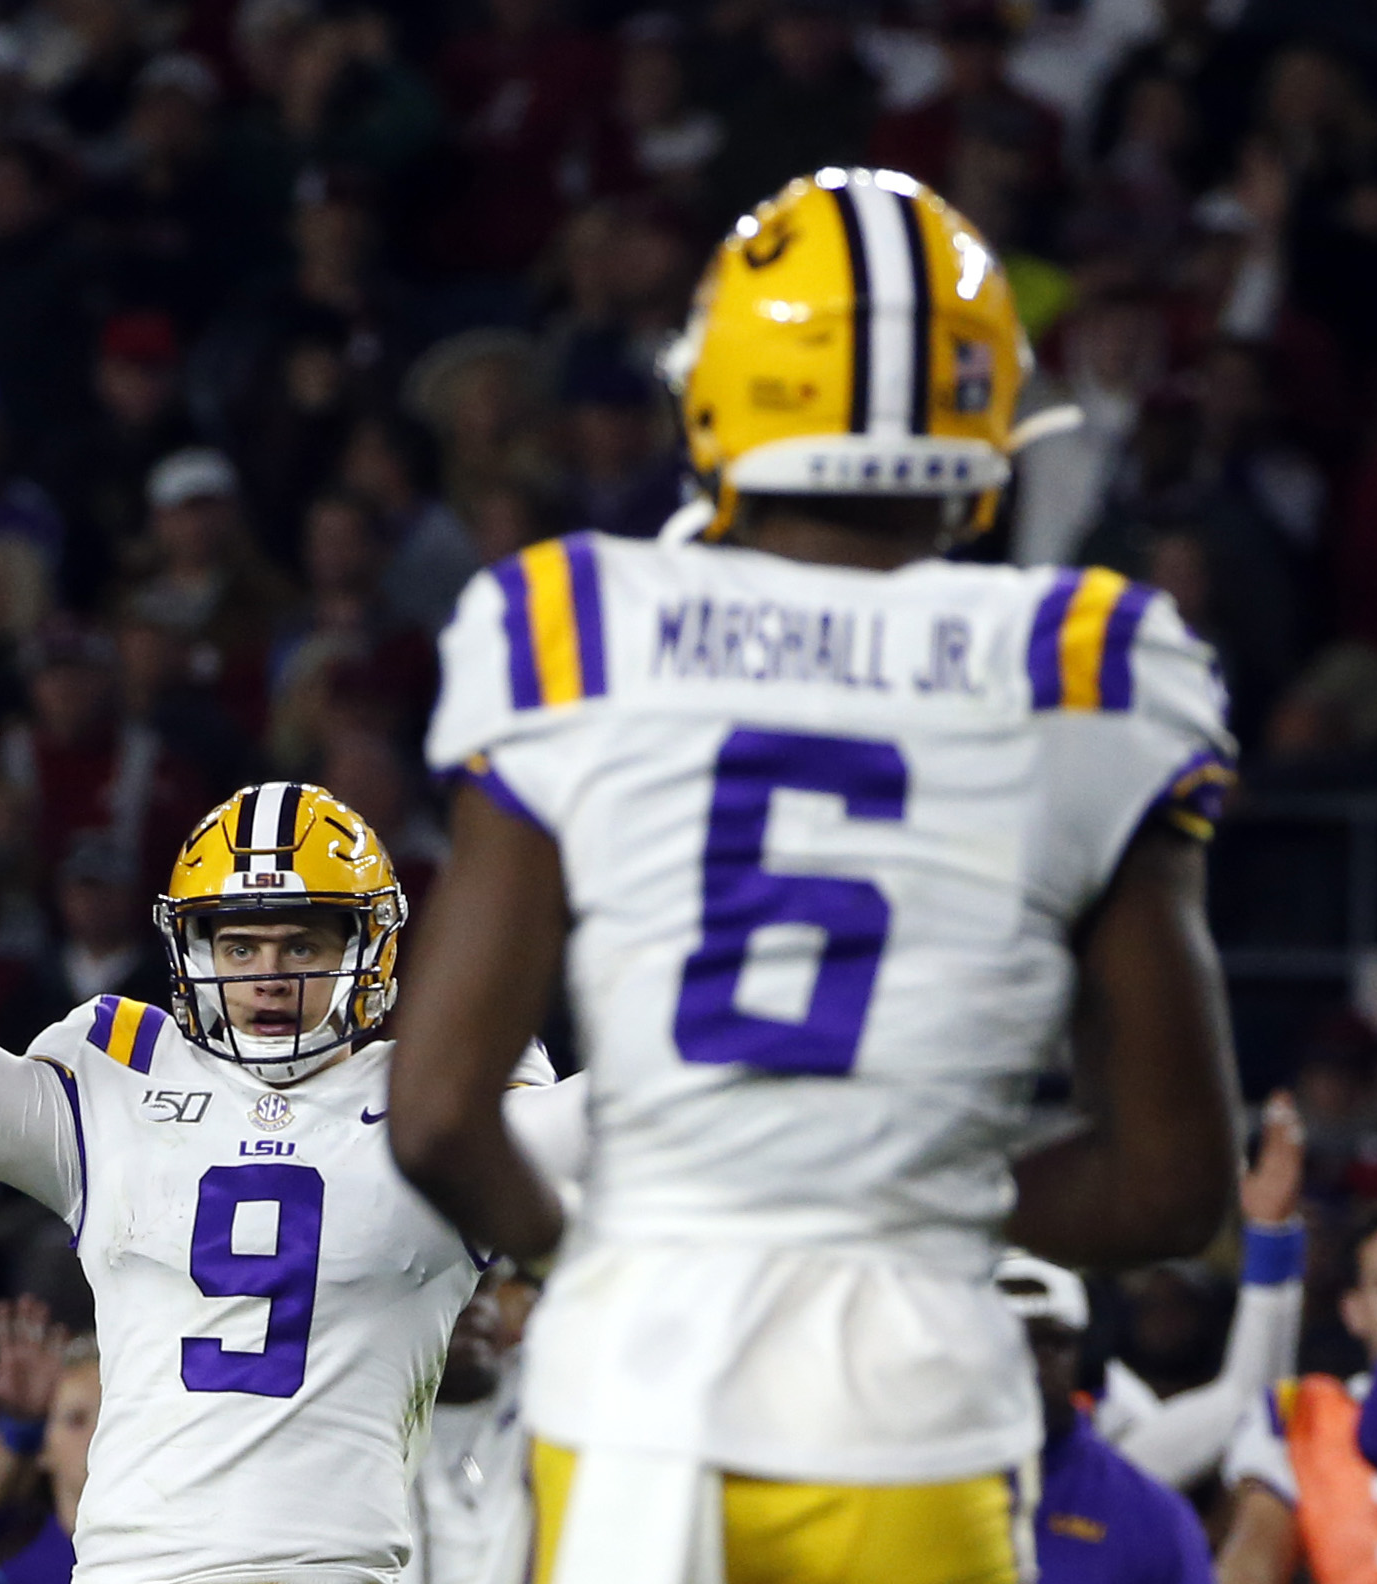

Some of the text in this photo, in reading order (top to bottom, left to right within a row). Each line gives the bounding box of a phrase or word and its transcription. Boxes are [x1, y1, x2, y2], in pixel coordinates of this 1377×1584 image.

[650, 598, 890, 691] MARSHALL
[243, 873, 285, 889] LSU
[673, 727, 909, 1074] 6
[258, 1093, 289, 1121] SEC
[239, 1140, 296, 1156] LSU
[180, 1163, 325, 1398] 9
